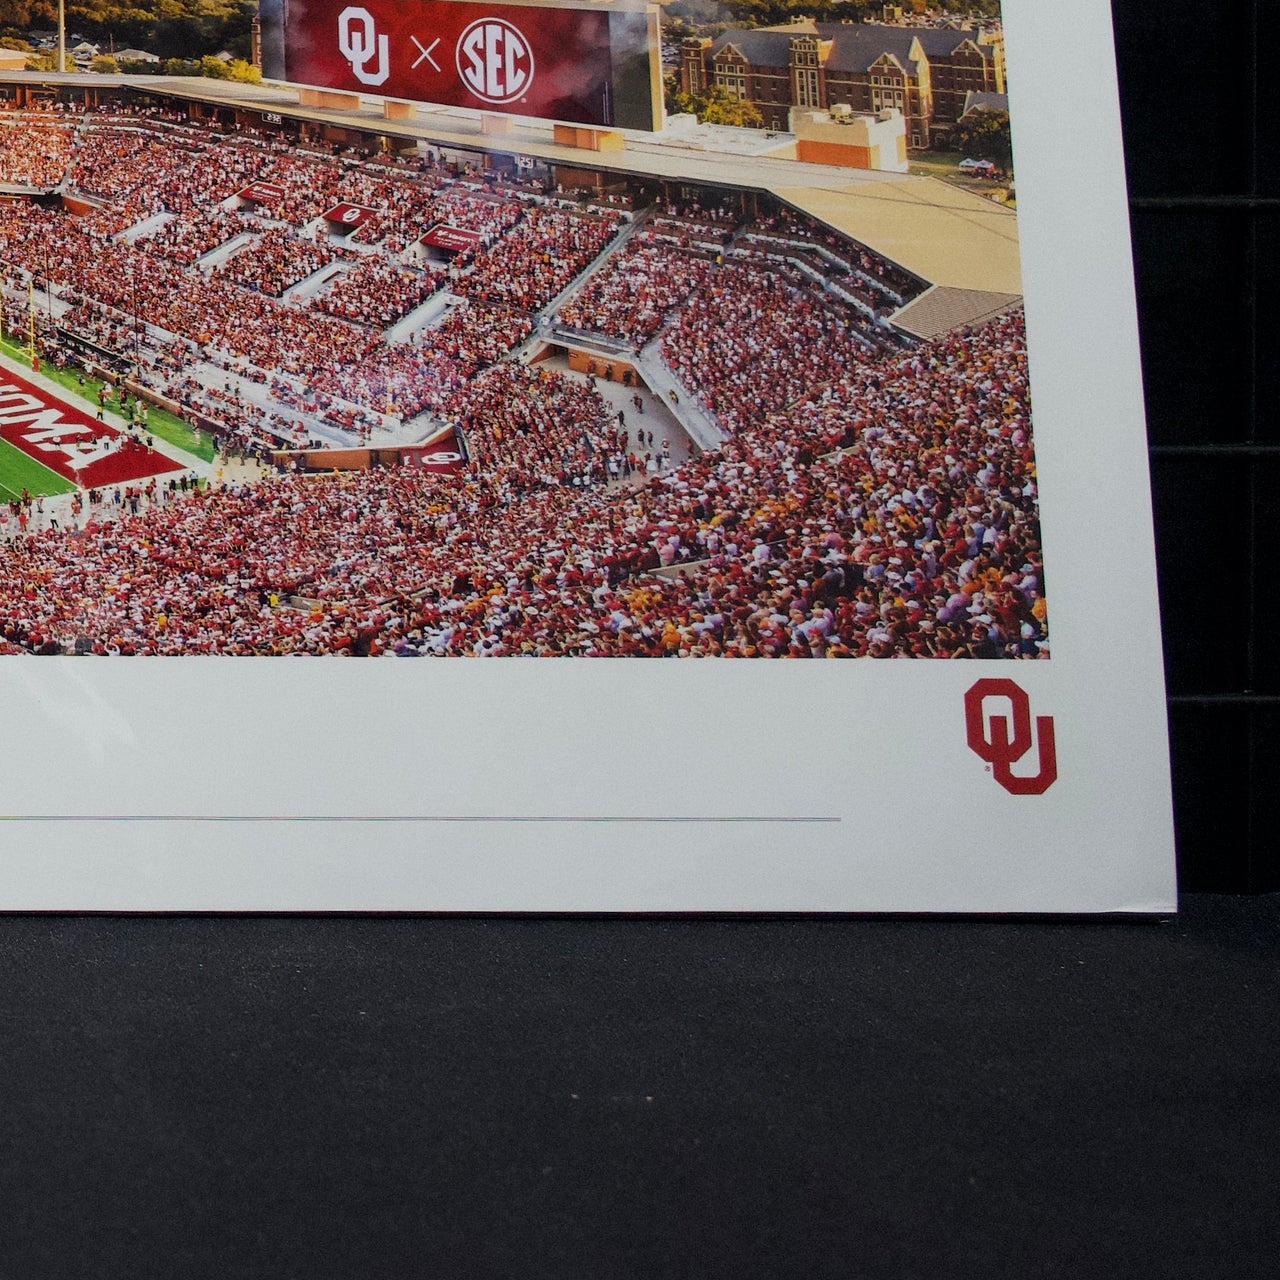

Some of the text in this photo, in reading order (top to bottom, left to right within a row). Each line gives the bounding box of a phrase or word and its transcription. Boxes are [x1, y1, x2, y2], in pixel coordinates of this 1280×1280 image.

[338, 6, 389, 87] OU
[461, 24, 526, 97] SEC
[963, 678, 1058, 795] OU
